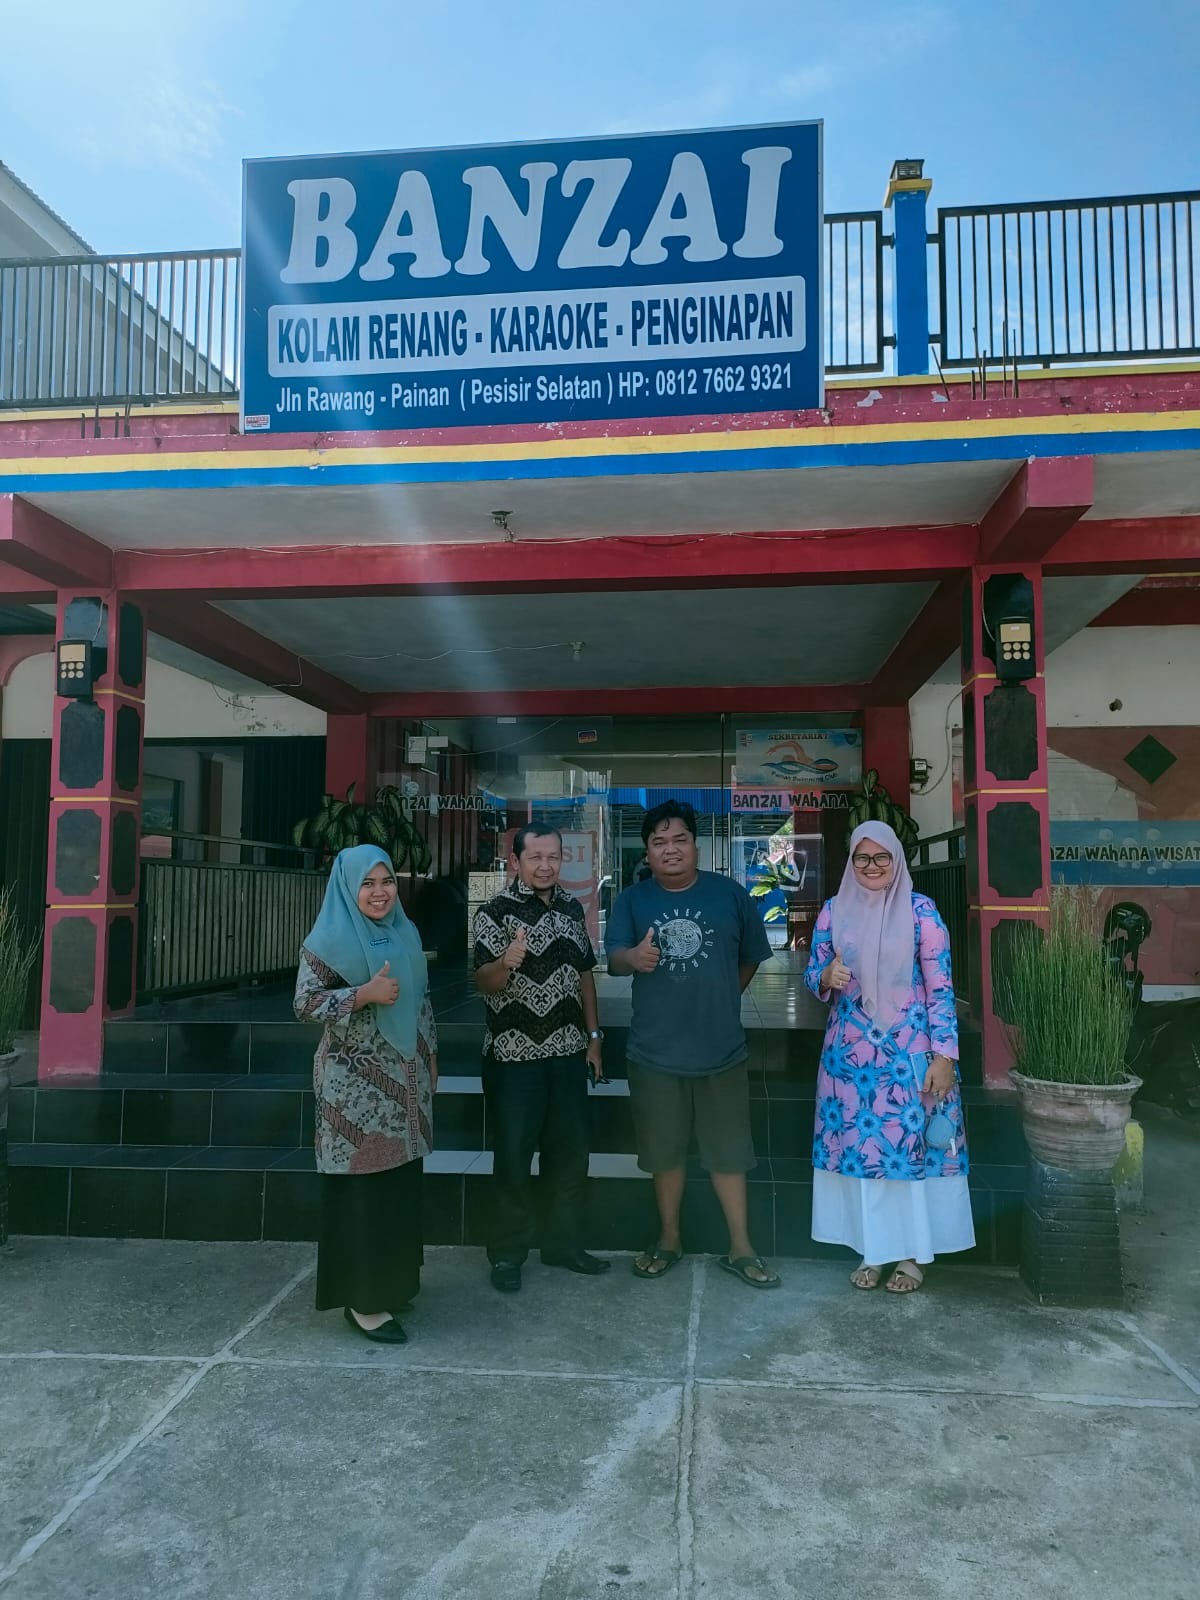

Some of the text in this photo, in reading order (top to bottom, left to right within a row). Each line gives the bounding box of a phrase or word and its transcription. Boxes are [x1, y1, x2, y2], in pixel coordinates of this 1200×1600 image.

[279, 145, 793, 285] BANZAI
[278, 315, 361, 364] KOLAM
[368, 308, 468, 361] RENANG
[490, 301, 609, 354] KARAOKE
[631, 290, 793, 347] PENGINAPAN
[275, 387, 302, 413] Jln
[307, 386, 375, 416] Rawang
[391, 382, 450, 408] Painan
[619, 371, 650, 397] HP:
[655, 368, 698, 396] 0812
[702, 365, 746, 393] 7662
[750, 362, 792, 391] 9321
[768, 733, 828, 741] SEKRETARIAT
[1154, 846, 1200, 861] WISAT
[653, 908, 702, 927] NEVER
